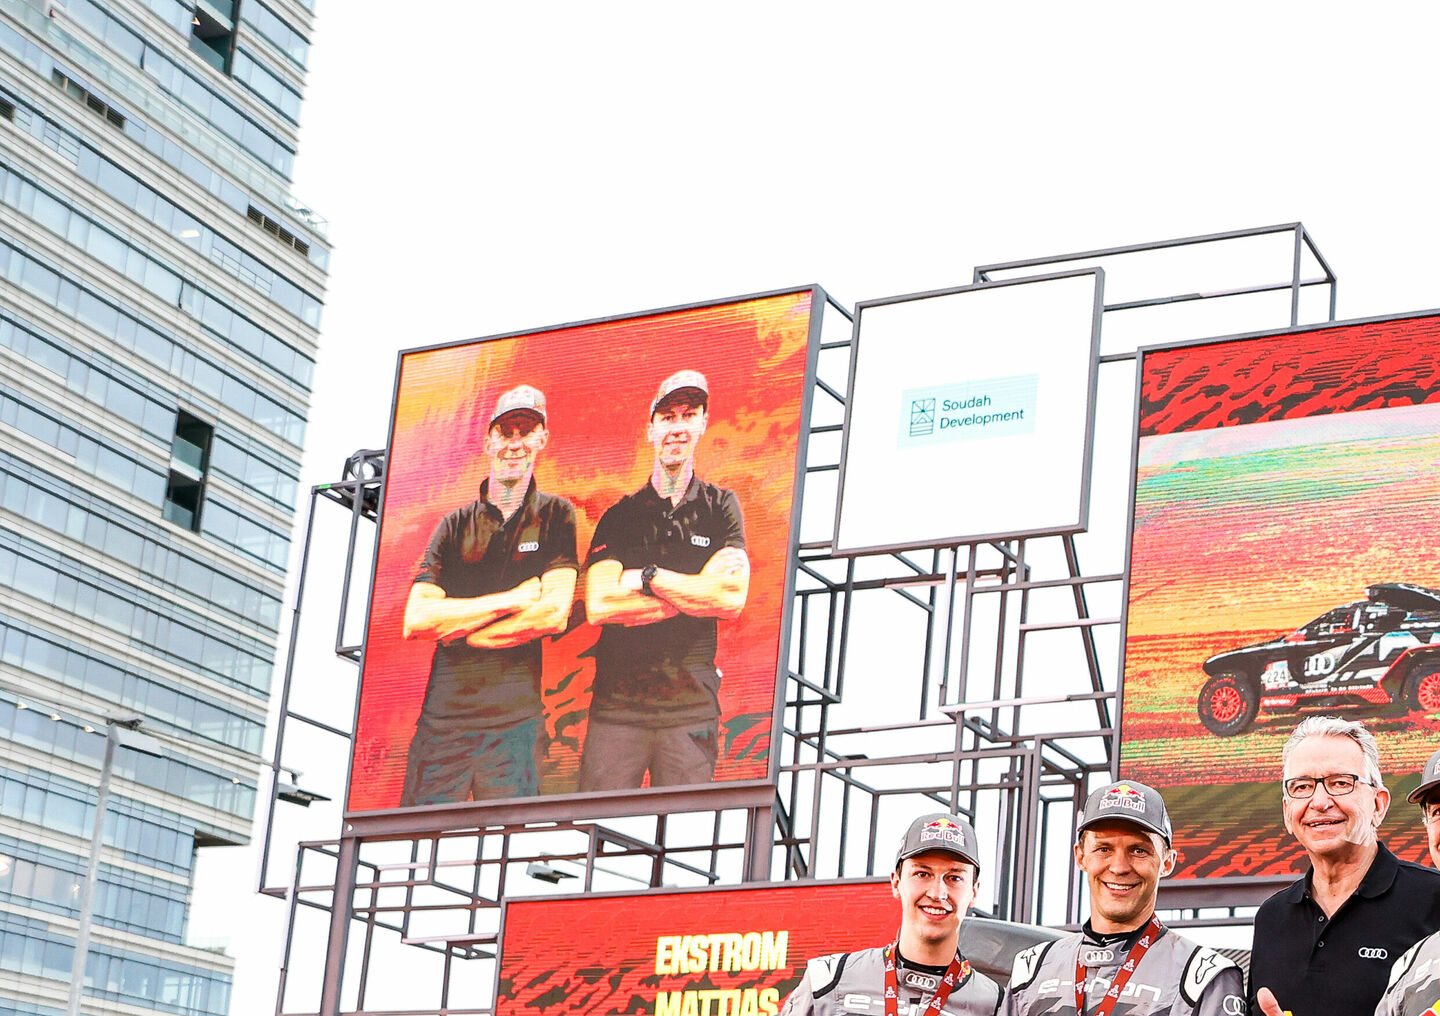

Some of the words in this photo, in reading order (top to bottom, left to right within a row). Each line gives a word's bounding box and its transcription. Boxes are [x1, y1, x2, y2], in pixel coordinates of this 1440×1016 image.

[942, 394, 992, 412] Soudah
[939, 408, 1025, 430] Development
[1099, 797, 1121, 810] Red
[1122, 797, 1146, 813] Bull
[921, 830, 943, 841] Red
[654, 930, 789, 976] EKSTROM
